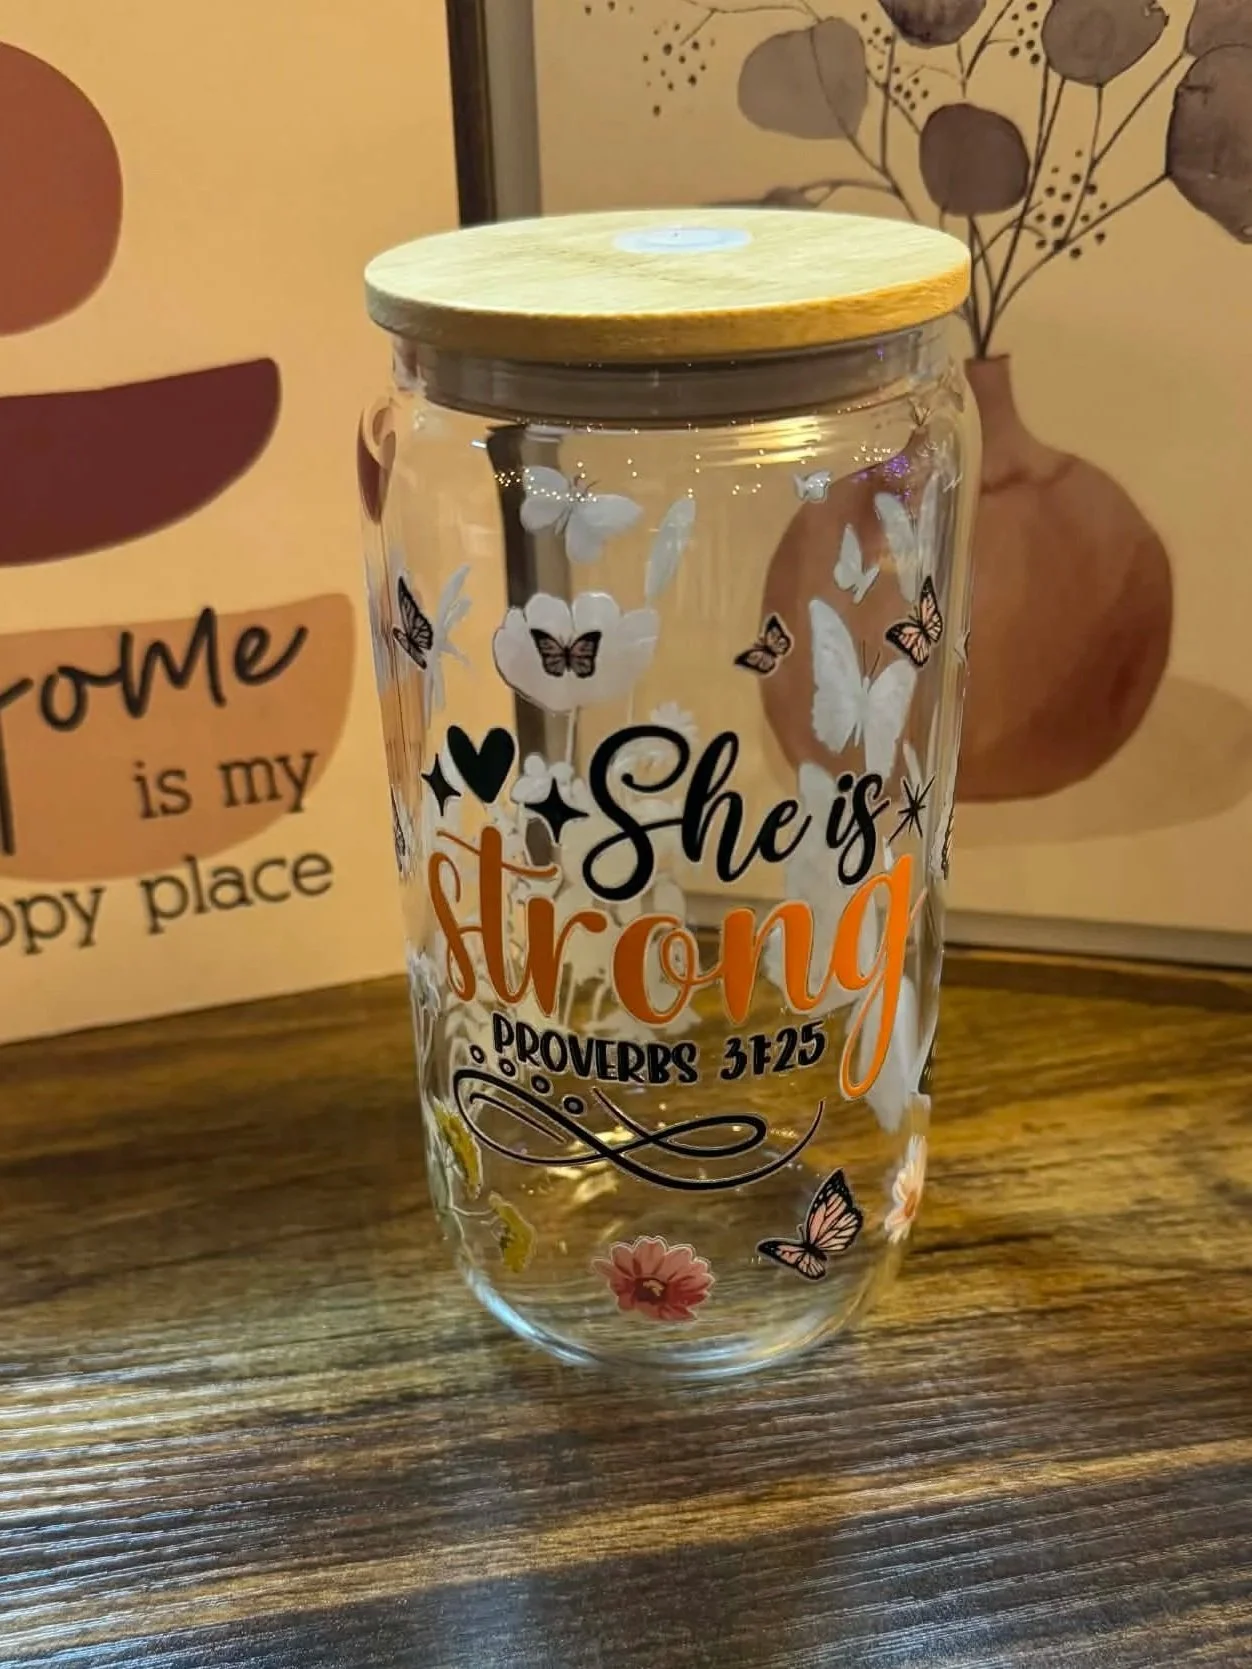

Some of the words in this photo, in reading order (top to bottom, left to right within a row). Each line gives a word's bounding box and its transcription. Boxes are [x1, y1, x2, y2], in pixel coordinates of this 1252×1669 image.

[132, 760, 193, 819] is
[217, 752, 317, 813] my
[582, 725, 812, 902] She
[825, 773, 890, 885] is
[139, 852, 333, 935] place
[427, 826, 928, 1098] strong
[492, 1012, 699, 1086] PROVERBS
[720, 1020, 828, 1082] 31:25
